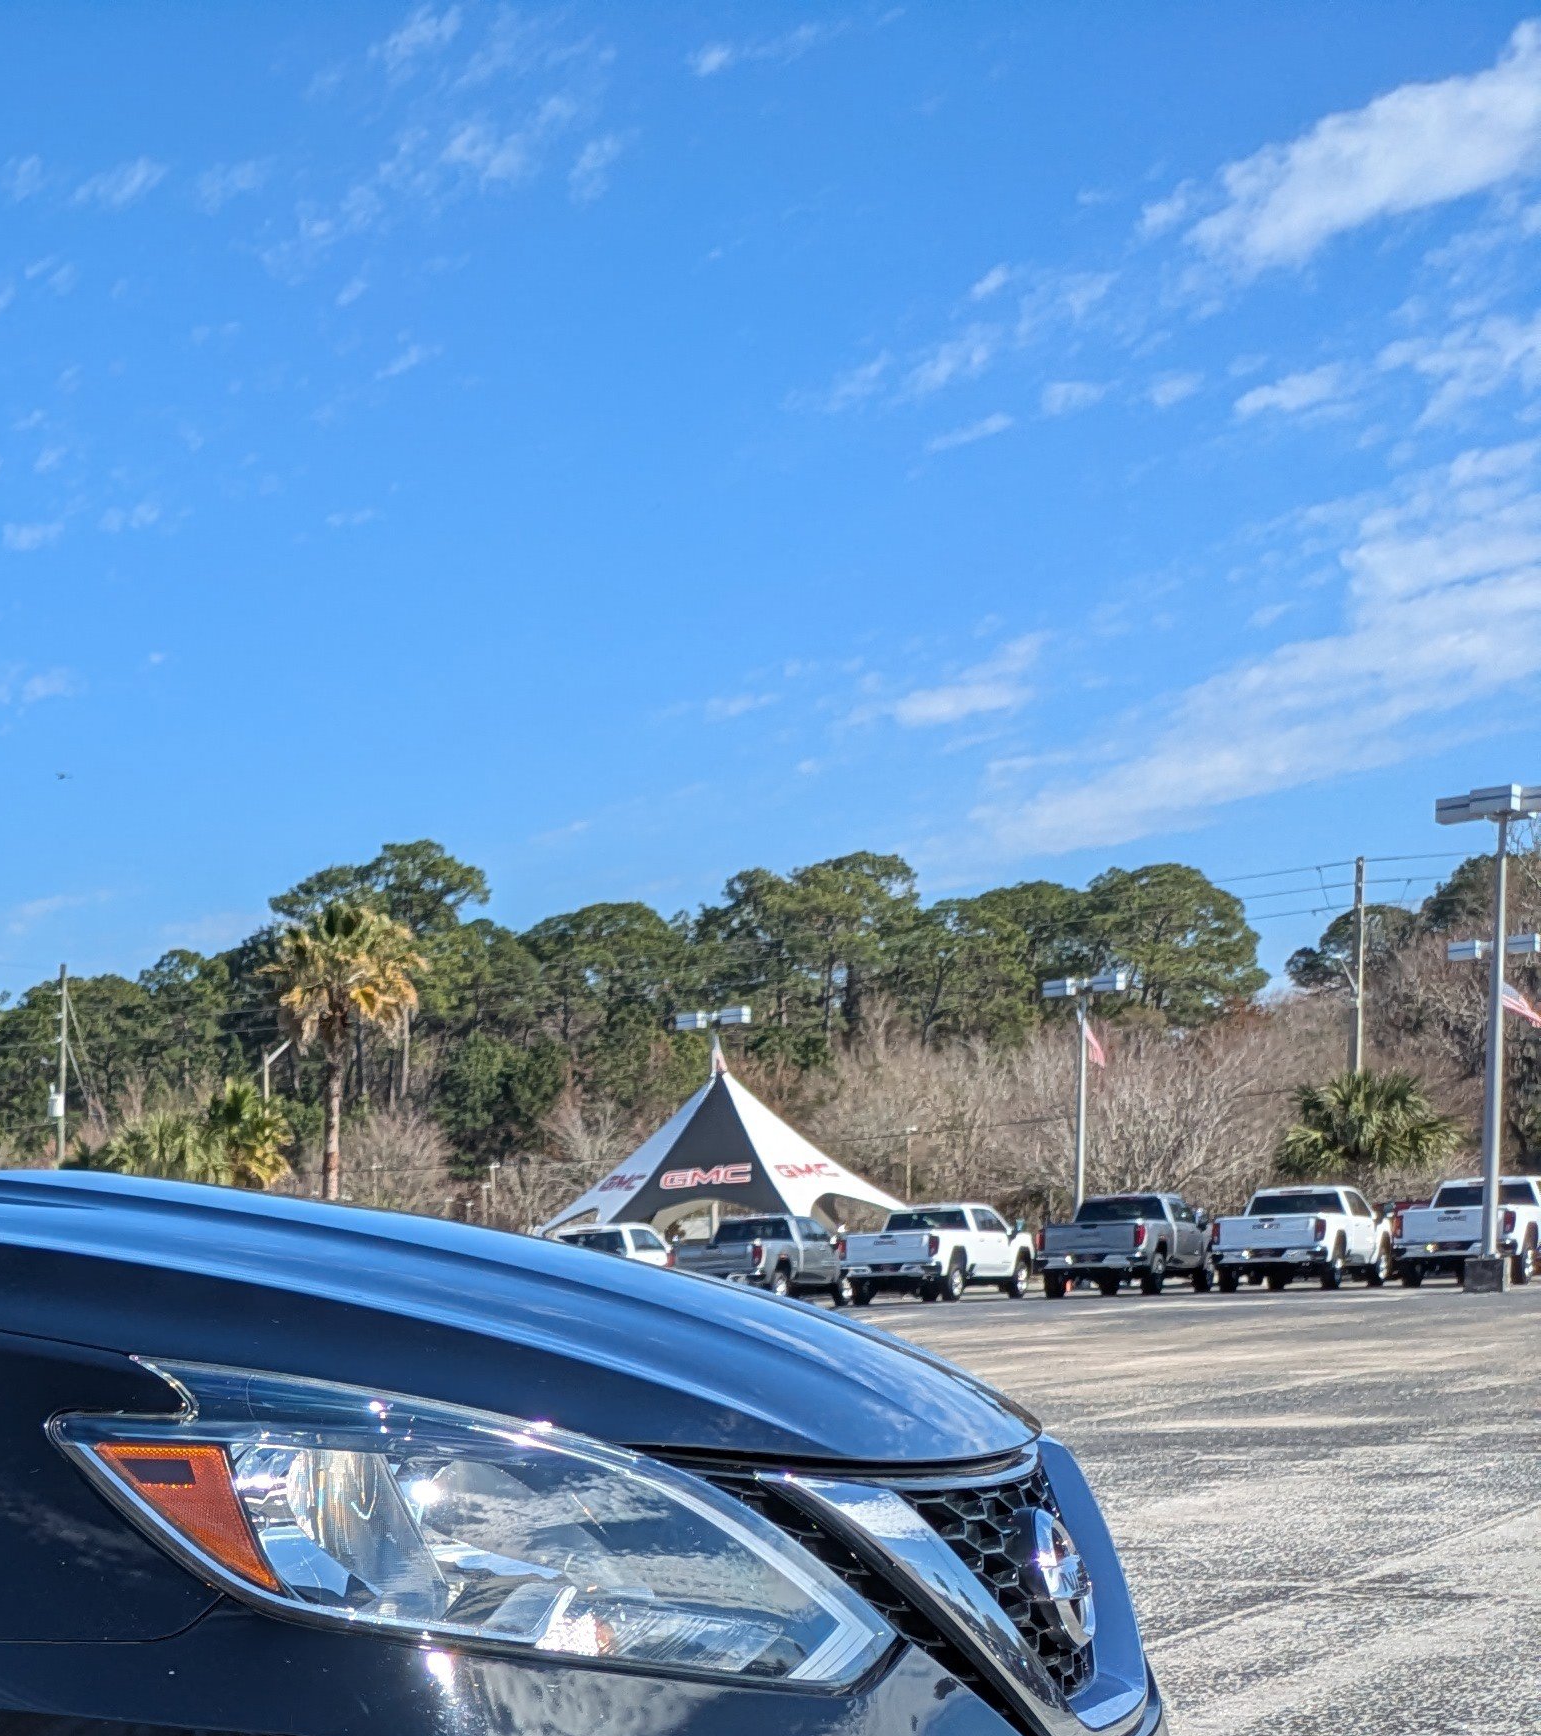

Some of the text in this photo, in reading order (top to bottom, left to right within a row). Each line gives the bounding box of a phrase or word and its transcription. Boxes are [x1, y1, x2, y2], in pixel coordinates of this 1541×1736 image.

[660, 1163, 752, 1190] GMC
[774, 1163, 840, 1179] GMC
[599, 1173, 647, 1192] GMC
